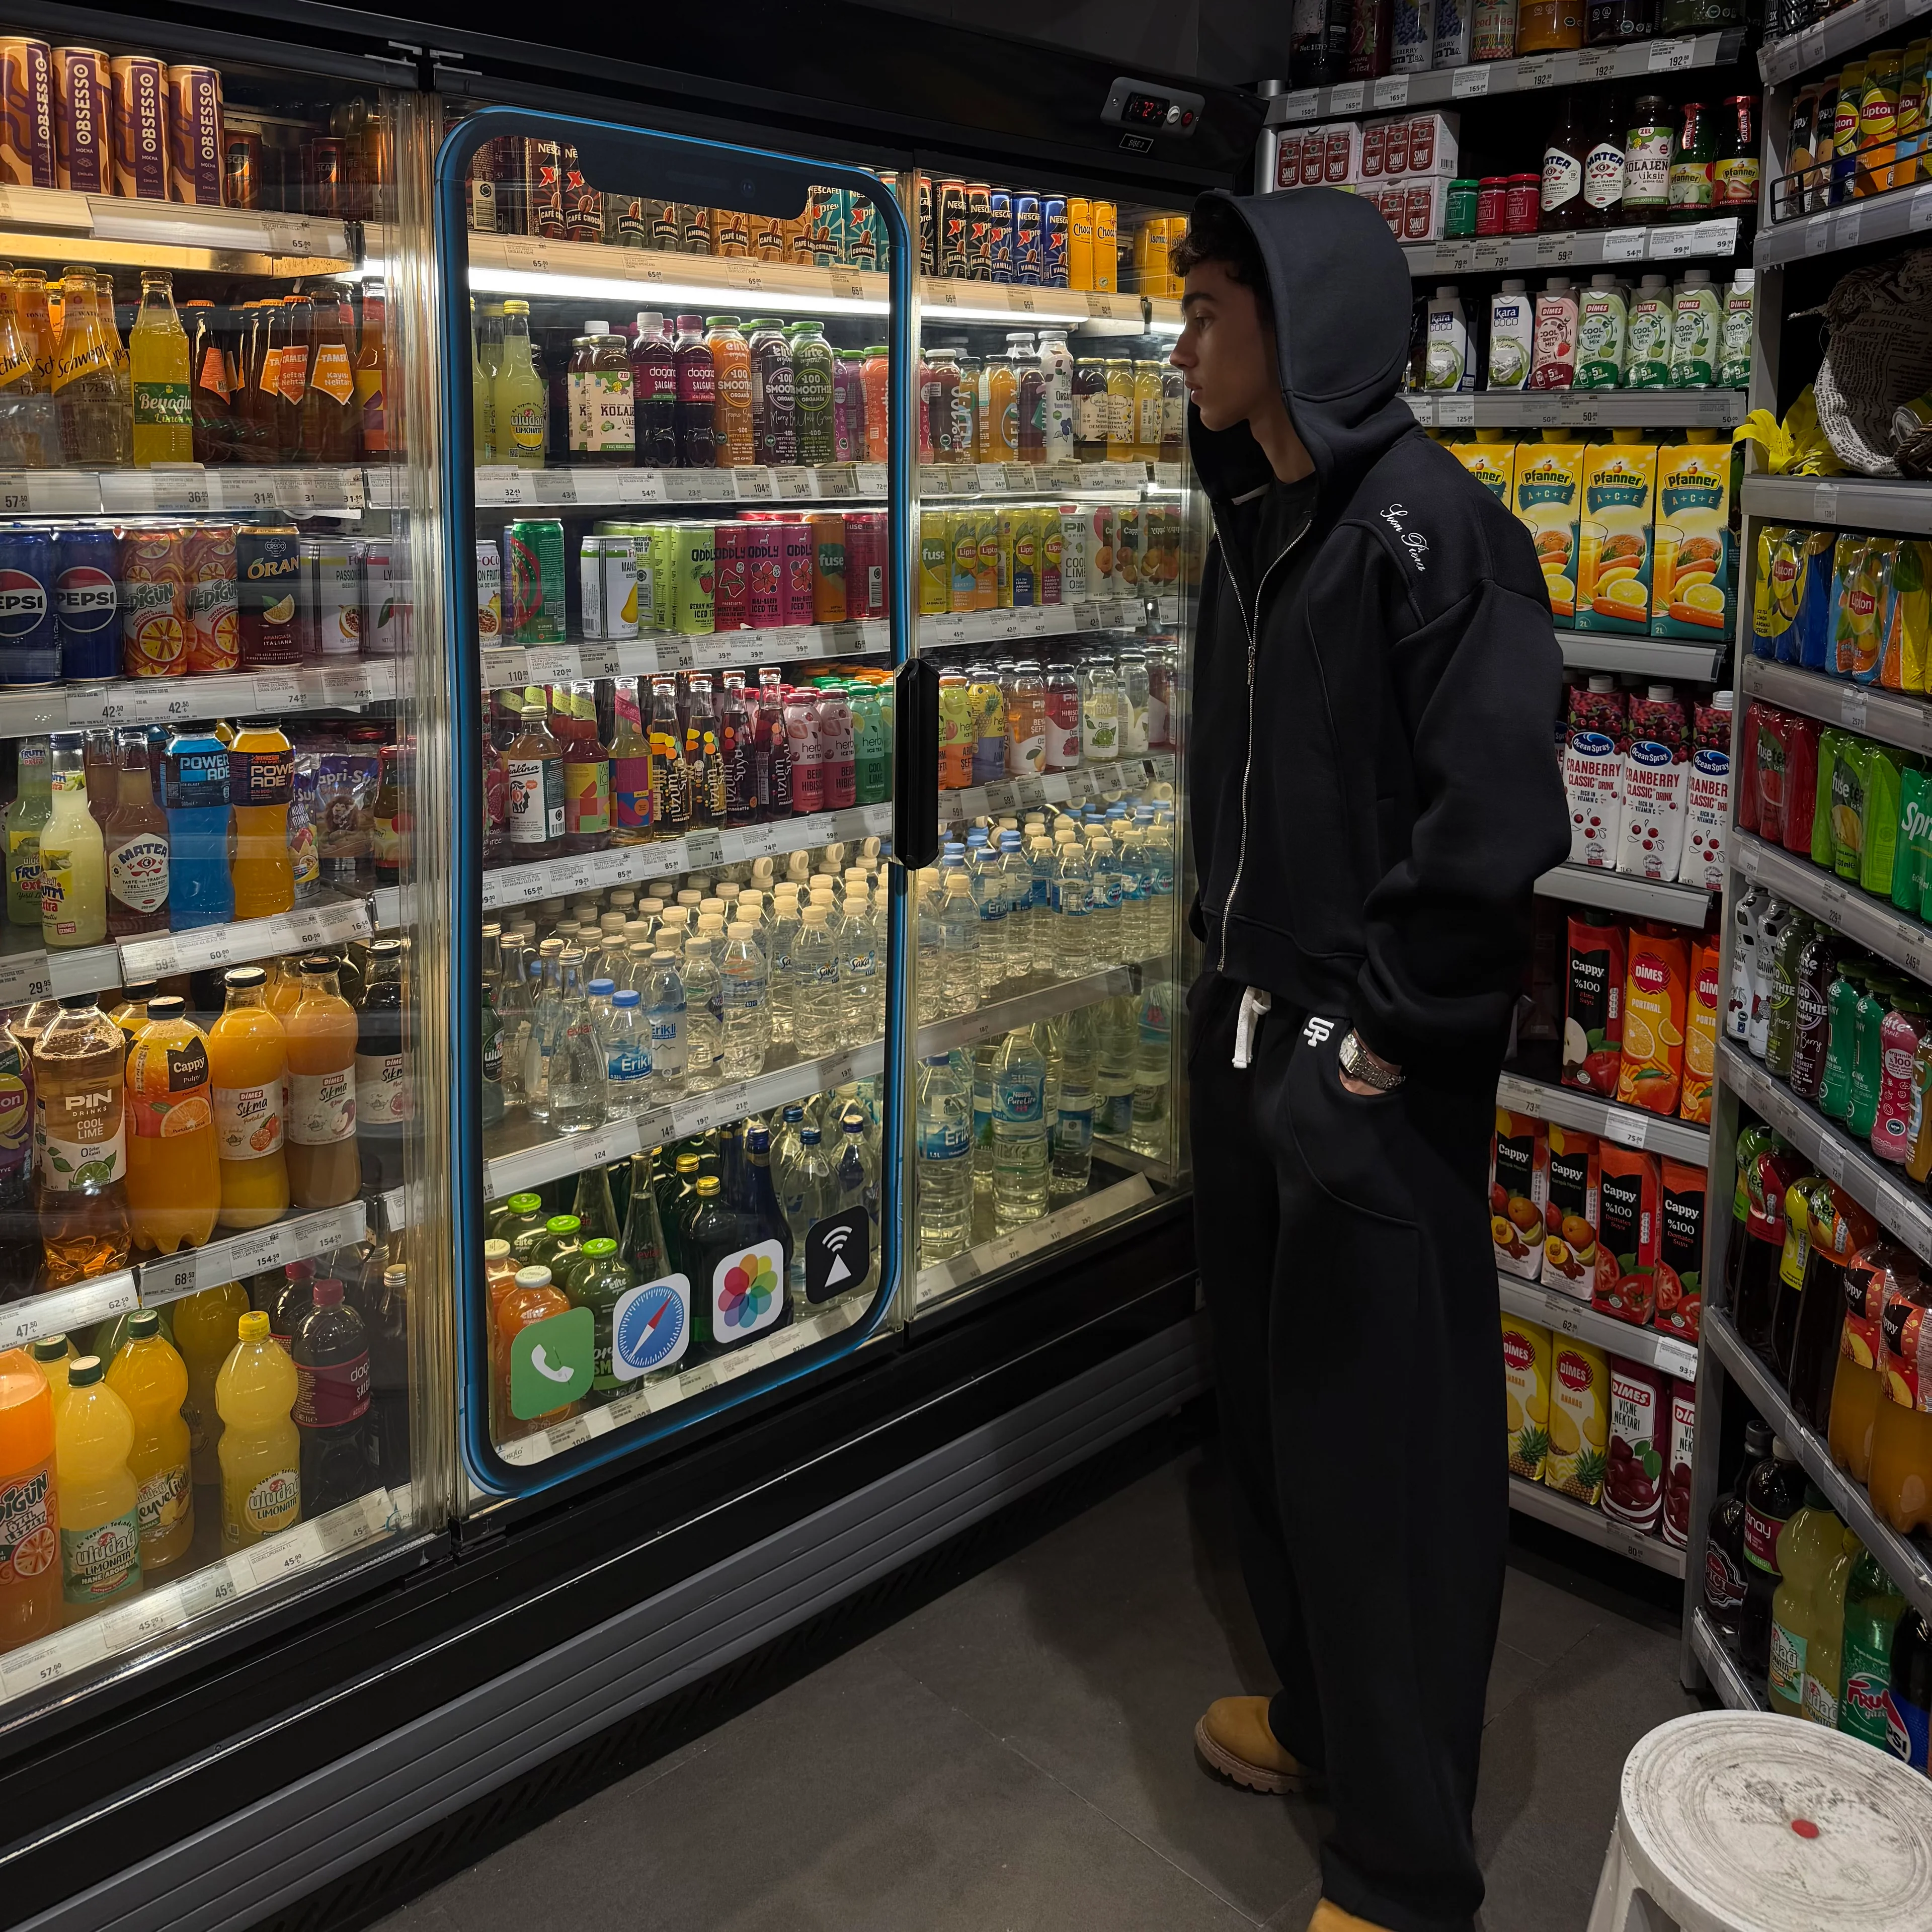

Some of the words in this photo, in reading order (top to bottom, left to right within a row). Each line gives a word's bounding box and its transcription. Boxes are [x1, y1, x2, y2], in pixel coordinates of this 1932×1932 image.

[1474, 15, 1496, 27] Iced
[1497, 15, 1513, 25] tea
[36, 57, 49, 140] OBSESSO
[73, 63, 91, 145] OBSESSO
[140, 73, 156, 152] OBSESSO
[1863, 103, 1896, 120] Lipton
[199, 82, 214, 160] OBSESSO
[1586, 152, 1624, 169] MATEA
[1643, 173, 1664, 181] iksir
[1724, 170, 1755, 179] Pfanner
[1020, 264, 1039, 273] VANILLA
[1431, 313, 1450, 324] kara
[1496, 307, 1516, 318] kara
[1430, 323, 1453, 332] COCO
[1494, 318, 1518, 327] COCO
[1520, 470, 1570, 486] Pfanner
[1593, 471, 1642, 488] Pfanner
[1667, 472, 1718, 490] Pfanner
[748, 546, 779, 557] ODDLY
[922, 548, 945, 560] fuse
[819, 554, 844, 566] fuse
[57, 591, 115, 606] PEPSI
[1851, 597, 1872, 609] Lipton
[694, 610, 707, 618] ICED
[751, 605, 766, 613] ICED
[1573, 737, 1591, 751] Ocean
[1591, 743, 1610, 754] Spray
[1757, 739, 1772, 762] fuse
[180, 754, 229, 769] POWER
[1631, 748, 1649, 761] Ocean
[1649, 754, 1668, 764] Spray
[868, 762, 882, 773] COOL
[1566, 756, 1621, 777] CRANBERRY
[869, 773, 883, 784] LIME
[1625, 767, 1680, 787] CRANBERRY
[1832, 771, 1849, 796] fuse
[1598, 781, 1614, 790] DRINK
[1656, 792, 1672, 801] DRINK
[118, 843, 167, 865] MATEA
[1572, 959, 1605, 979] Cappy
[1574, 979, 1600, 993] %100
[1631, 998, 1662, 1014] PORTAKAL
[173, 1056, 205, 1074] Cappy
[183, 1074, 201, 1083] Pulpy
[324, 1076, 344, 1085] DİMES
[72, 1106, 108, 1117] DRINKS
[77, 1118, 104, 1130] COOL
[77, 1127, 104, 1140] LIME
[81, 1148, 89, 1157] 0
[1498, 1143, 1529, 1164] Cappy
[1551, 1161, 1584, 1181] Cappy
[1602, 1183, 1637, 1203] Cappy
[1604, 1202, 1633, 1218] %100
[1664, 1199, 1700, 1220] Cappy
[1667, 1219, 1695, 1235] %100
[1559, 1361, 1587, 1383] DİMES
[1612, 1383, 1649, 1405] DİMES
[7, 1512, 36, 1533] ÖZEL
[76, 1528, 136, 1566] uludağ
[85, 1551, 131, 1576] LİMONATA
